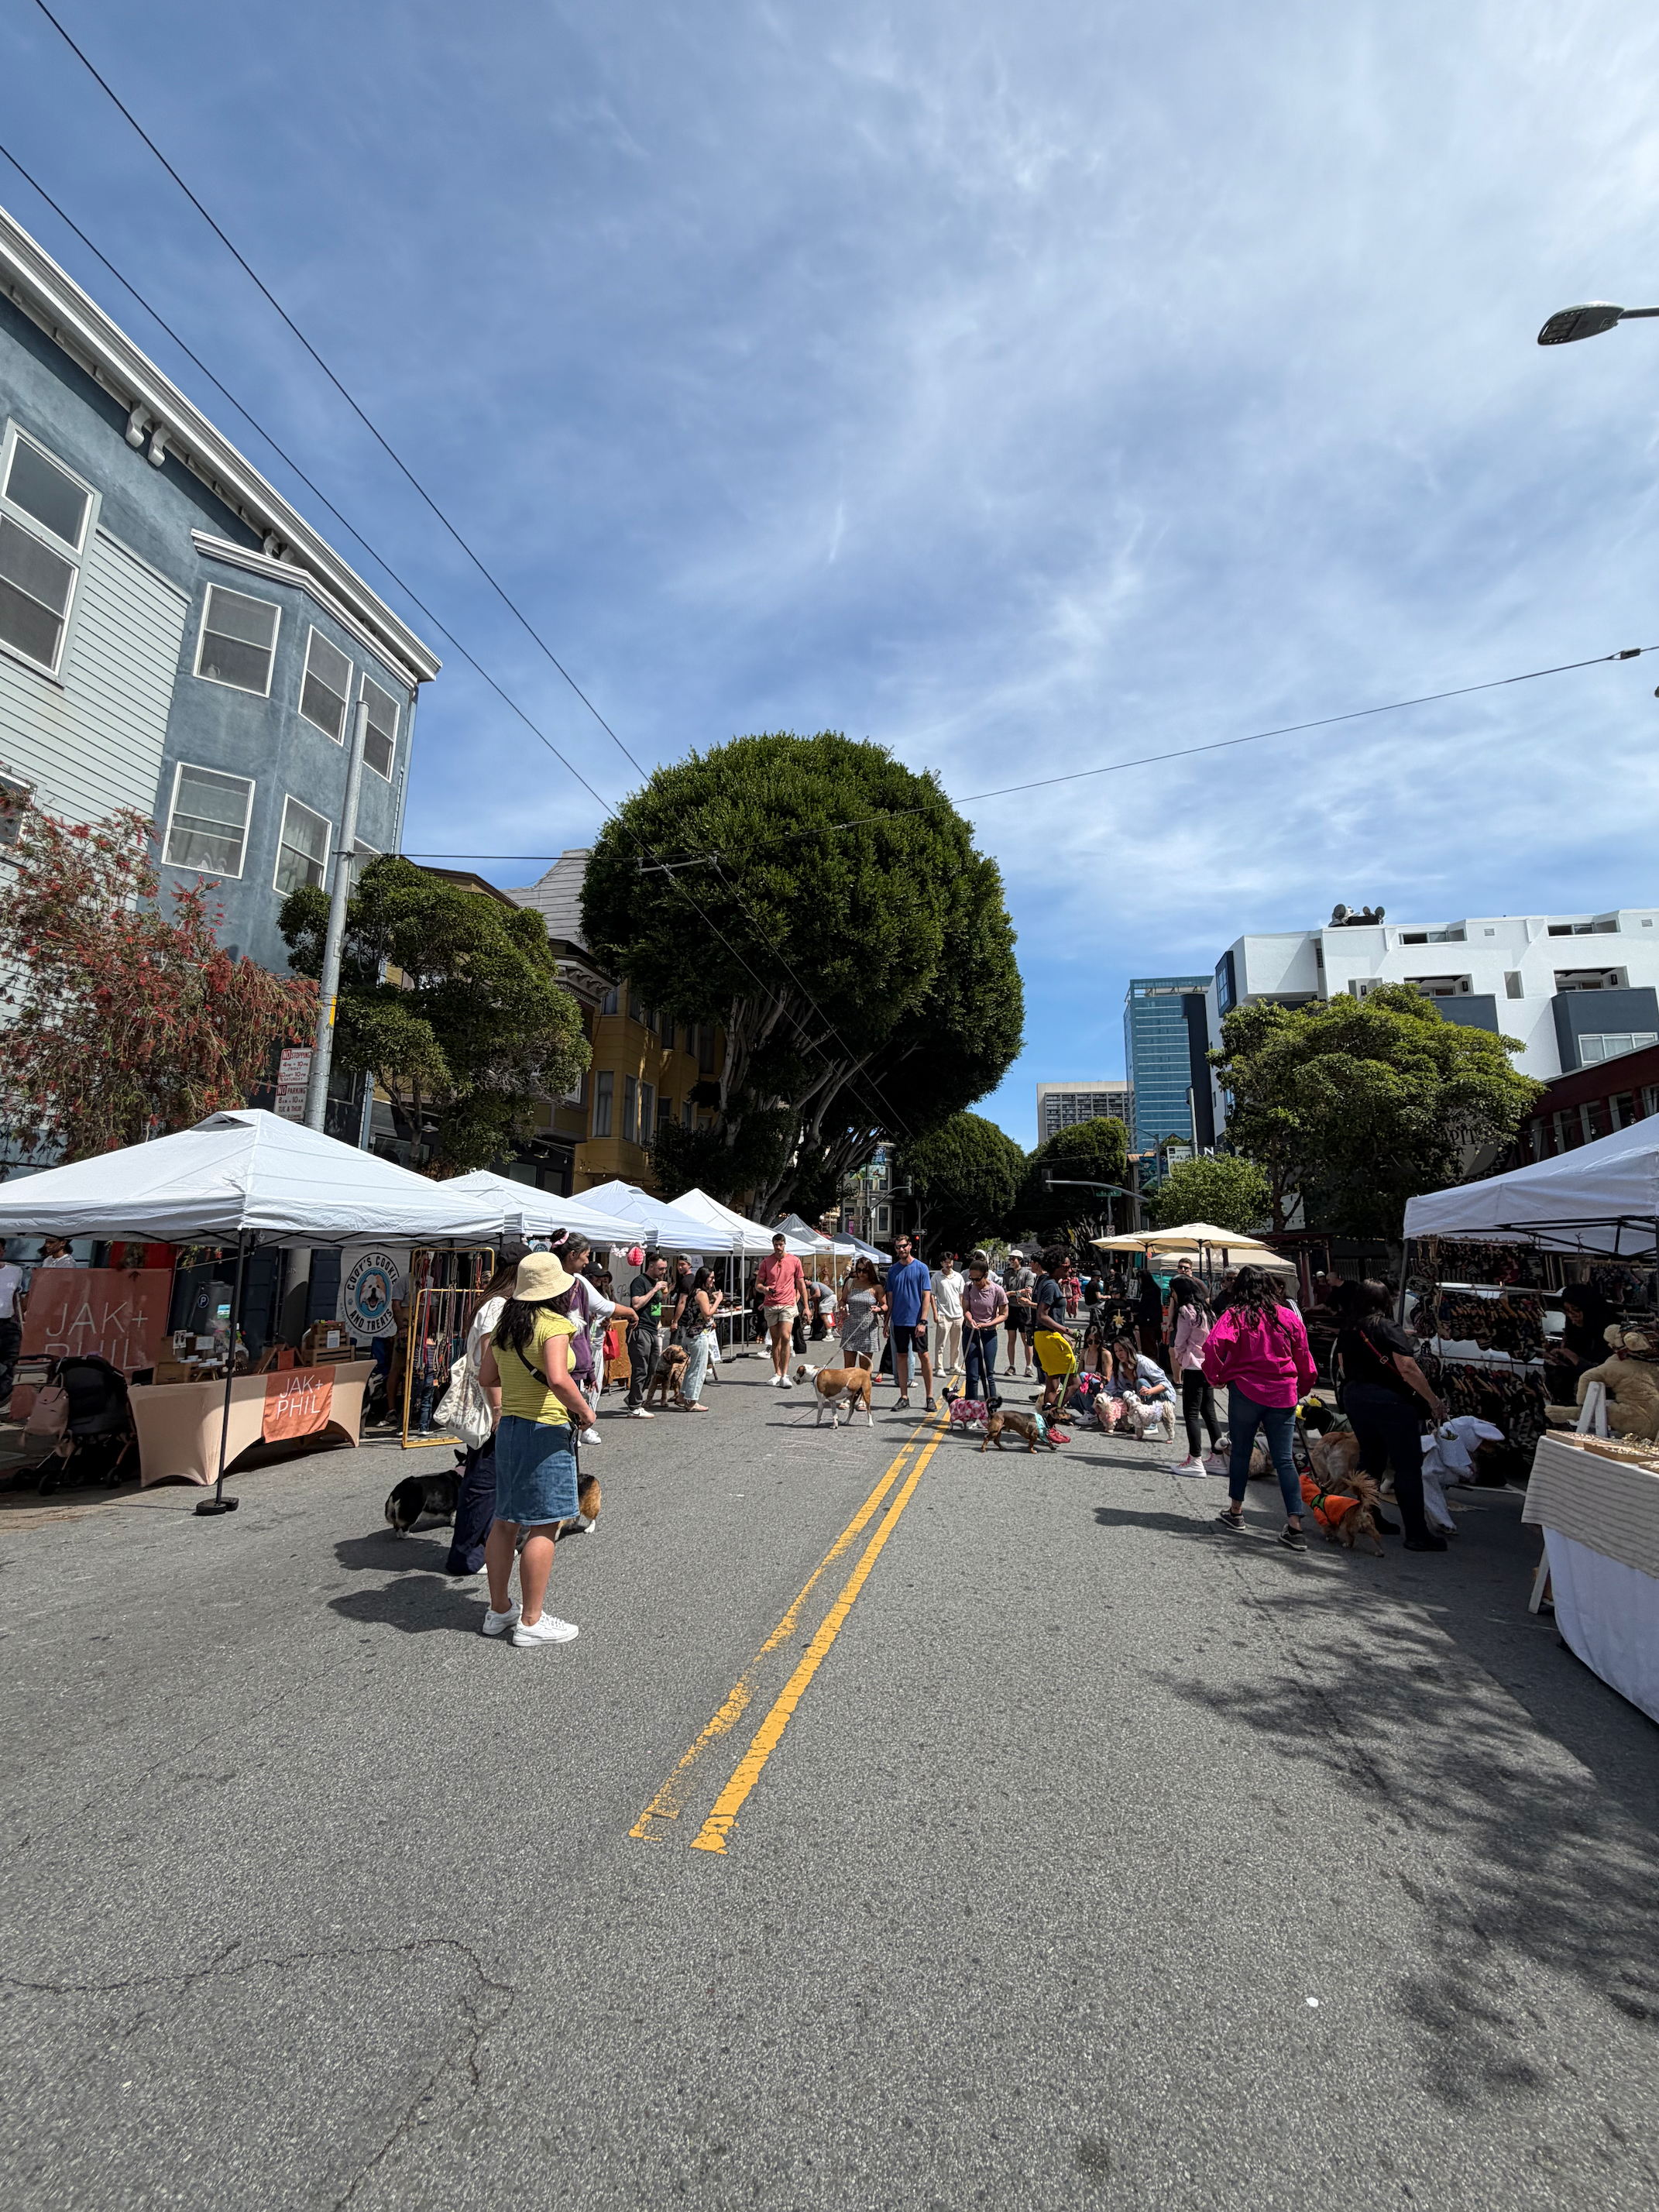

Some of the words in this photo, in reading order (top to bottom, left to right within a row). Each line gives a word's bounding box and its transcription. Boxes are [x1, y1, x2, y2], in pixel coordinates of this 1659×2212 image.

[283, 1050, 290, 1060] NO
[277, 1086, 286, 1094] NO
[347, 1257, 372, 1291] CODY'S
[200, 1296, 207, 1306] P
[349, 1310, 365, 1328] AND
[367, 1308, 393, 1331] TREATS
[276, 1395, 321, 1420] PHIL
